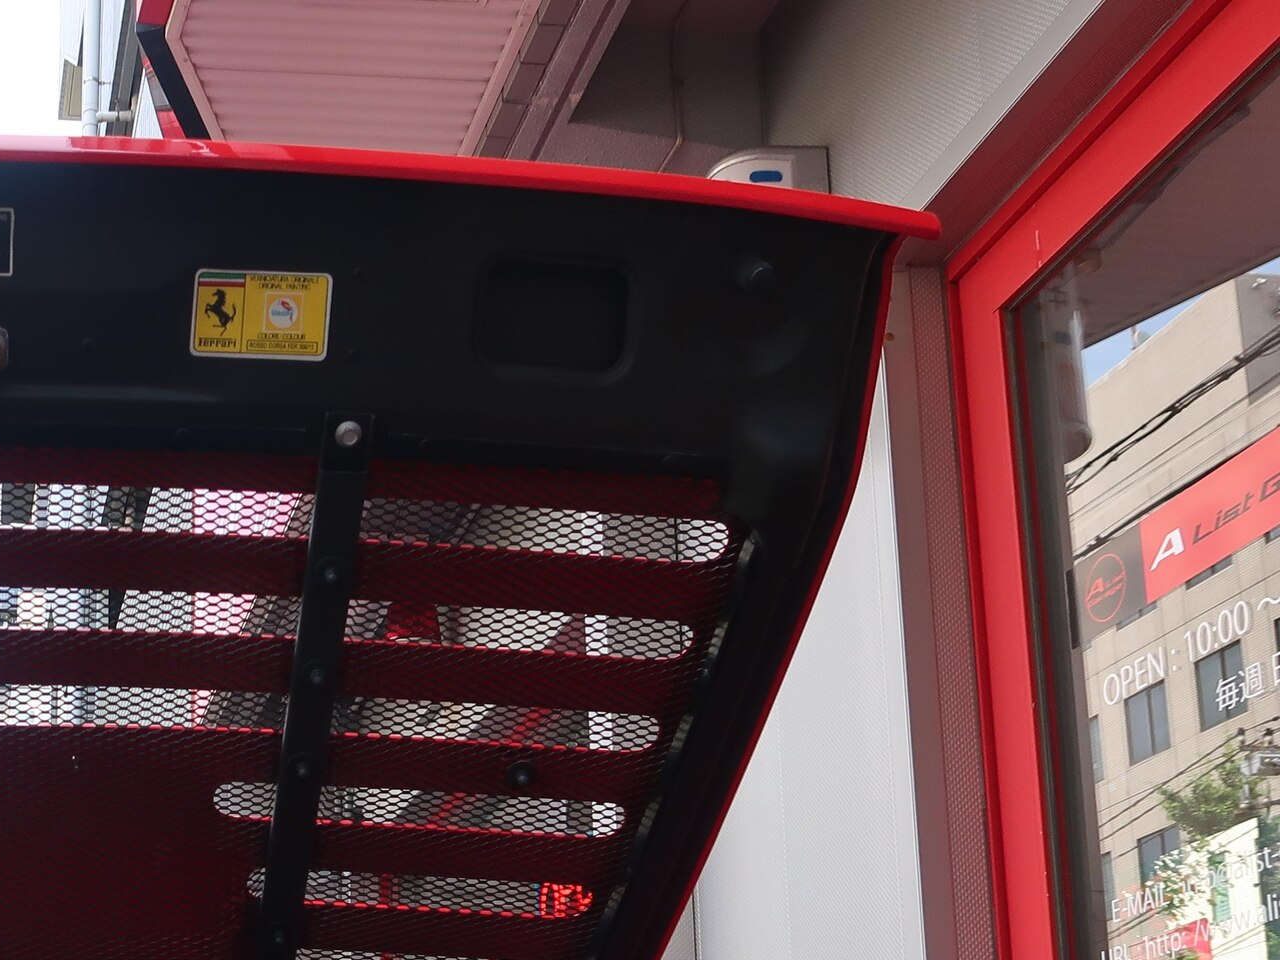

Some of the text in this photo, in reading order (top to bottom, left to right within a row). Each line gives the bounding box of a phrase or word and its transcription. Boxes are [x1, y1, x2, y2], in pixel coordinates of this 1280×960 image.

[198, 337, 237, 348] Ferrari
[1149, 527, 1185, 572] A
[1103, 600, 1249, 706] OPEN 10:00
